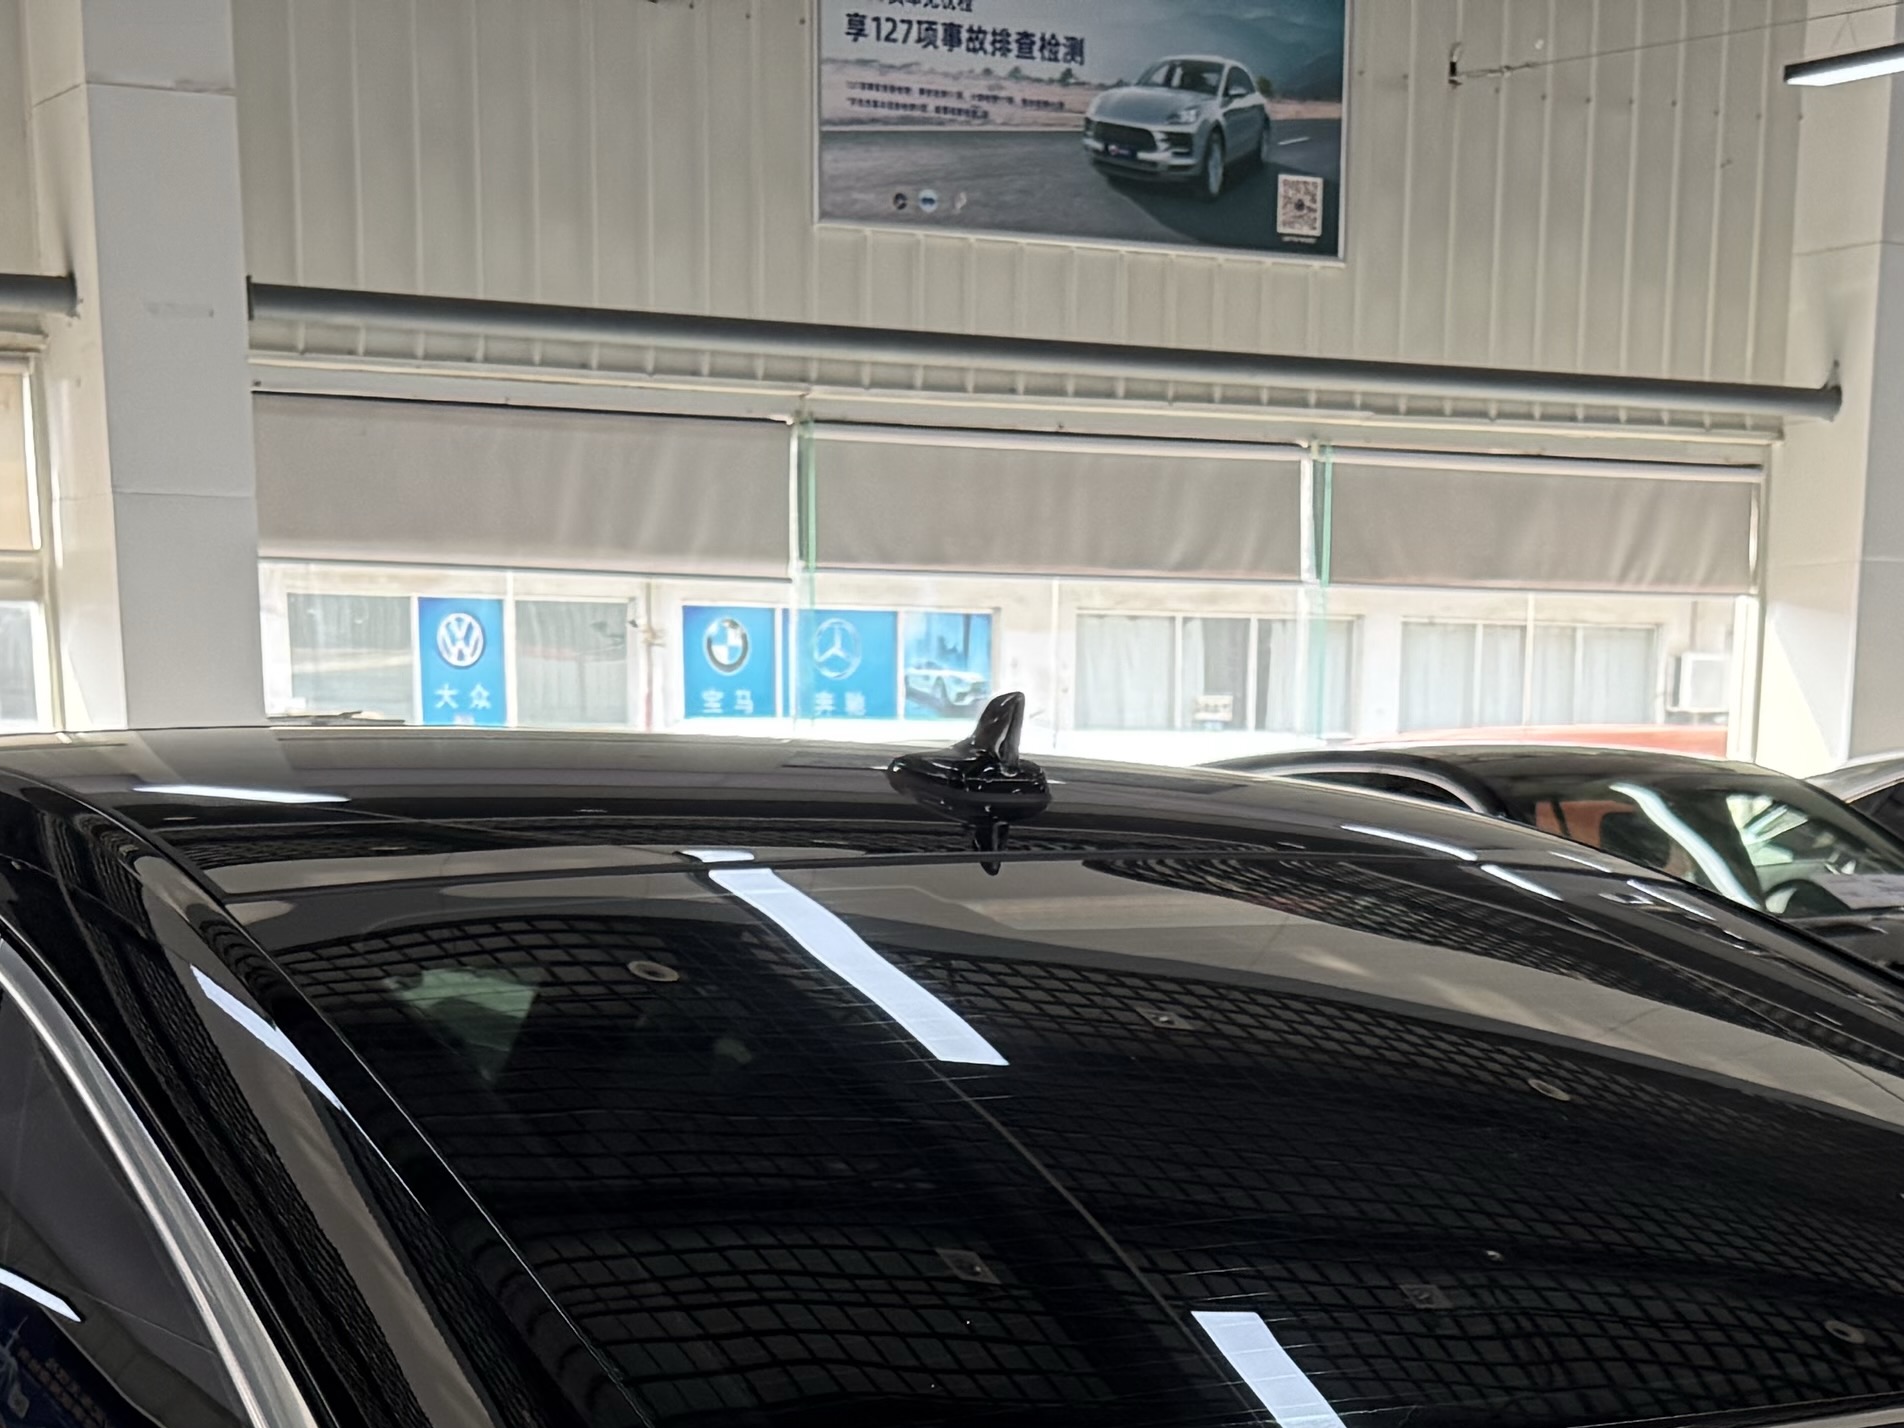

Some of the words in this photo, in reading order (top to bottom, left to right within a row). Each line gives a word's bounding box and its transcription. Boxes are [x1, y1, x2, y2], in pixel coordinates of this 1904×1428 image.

[845, 12, 1086, 67] 享127项事故排查检测
[435, 683, 492, 709] 大众
[701, 687, 755, 714] 宝马
